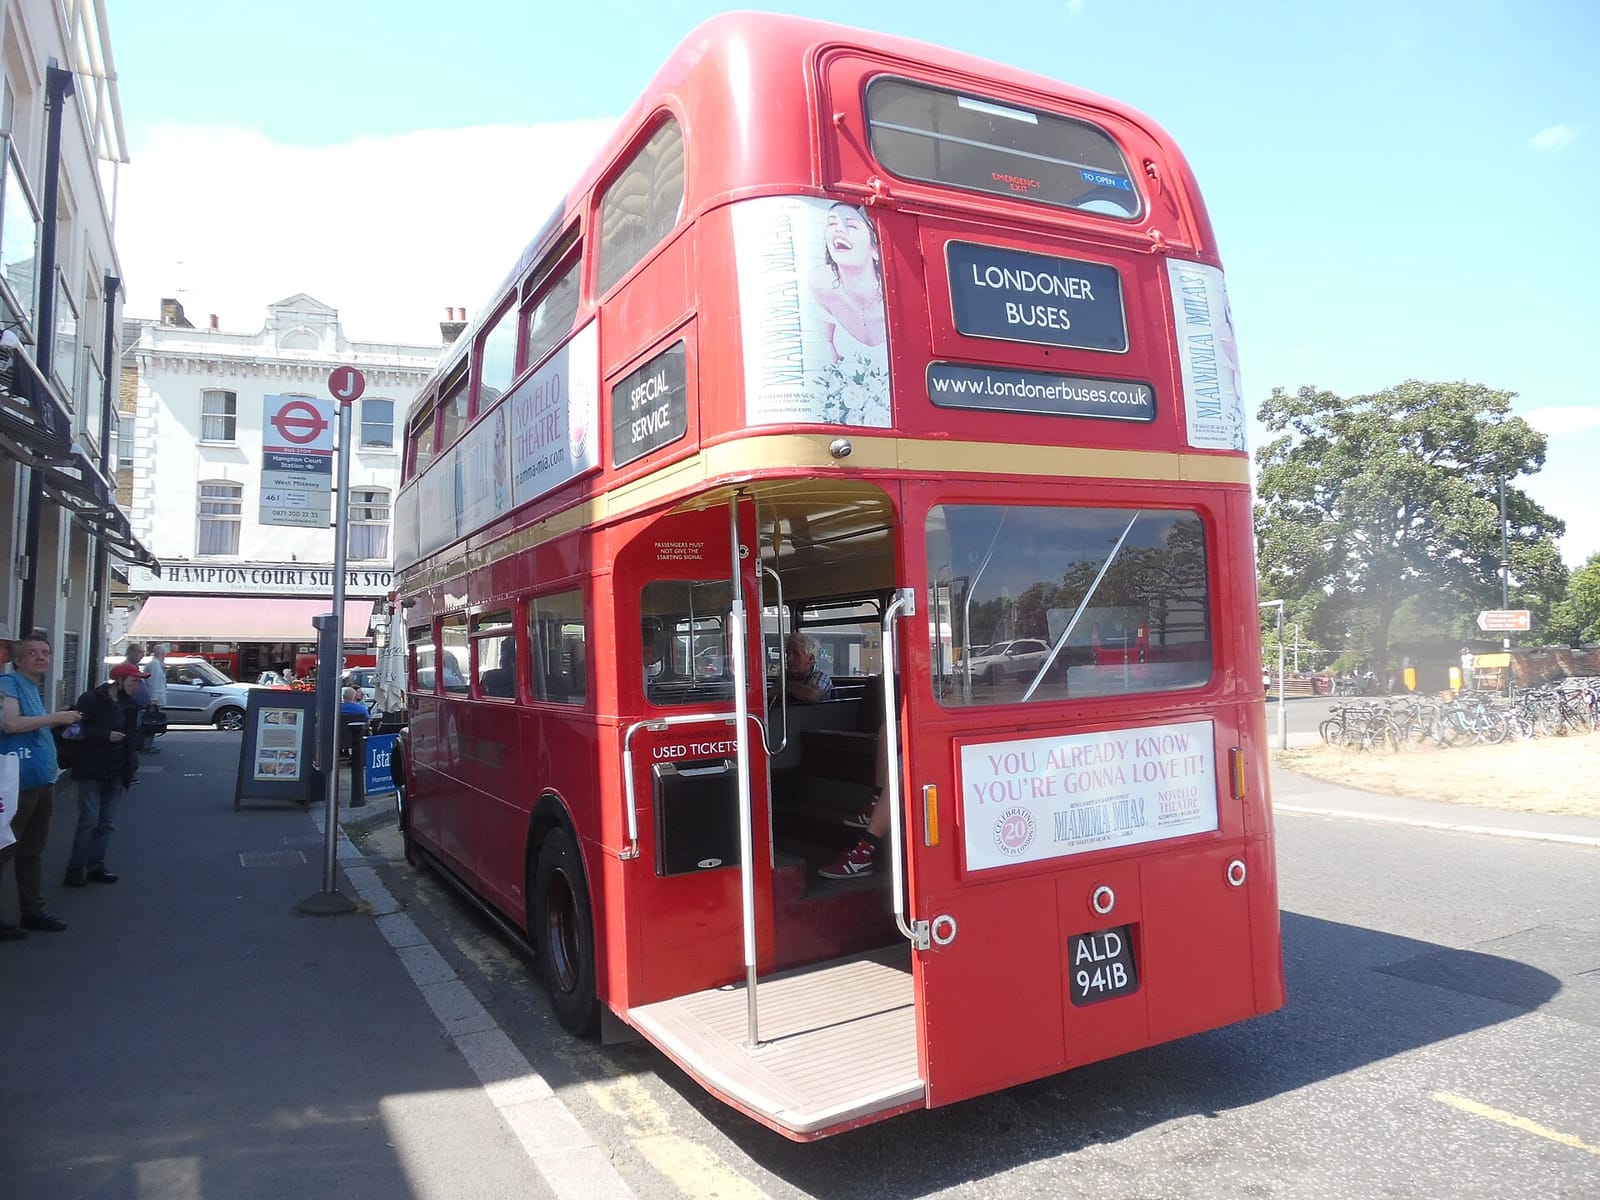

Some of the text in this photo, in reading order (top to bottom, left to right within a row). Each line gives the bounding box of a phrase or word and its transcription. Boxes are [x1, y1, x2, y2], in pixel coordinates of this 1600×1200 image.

[991, 172, 1041, 188] EMERGENCY
[1009, 183, 1028, 193] EXIT
[1082, 172, 1116, 186] TO OPEN
[972, 263, 1096, 301] LONDONER
[1006, 302, 1071, 330] BUSES
[1180, 275, 1213, 328] MIA!
[337, 371, 354, 397] J
[630, 369, 669, 411] SPECIAL
[932, 375, 1148, 406] www.londonerbuses.co.uk
[1188, 333, 1222, 421] MAMMA
[516, 373, 561, 432] NOVELLO
[516, 407, 562, 464] THEATRE
[631, 403, 671, 444] SERVICE
[272, 455, 303, 463] Hampton
[168, 567, 391, 587] HAMPTON COURT SUR STO
[372, 748, 392, 769] Ista
[652, 740, 738, 759] USED TICKETS
[987, 731, 1191, 778] YOU ALREADY KNOW
[972, 775, 1058, 806] YOU'RE
[1063, 764, 1127, 795] GONNA
[1133, 756, 1181, 785] LOVE
[1184, 754, 1206, 775] IT!
[1157, 785, 1198, 803] NOVELLO
[1053, 804, 1111, 843] MAMMA
[1112, 796, 1147, 832] MIA!
[1159, 797, 1198, 814] THEATRE
[995, 807, 1035, 835] CELEBRATING
[1005, 820, 1026, 841] 20
[1075, 932, 1121, 966] ALD
[1076, 962, 1128, 997] 941B
